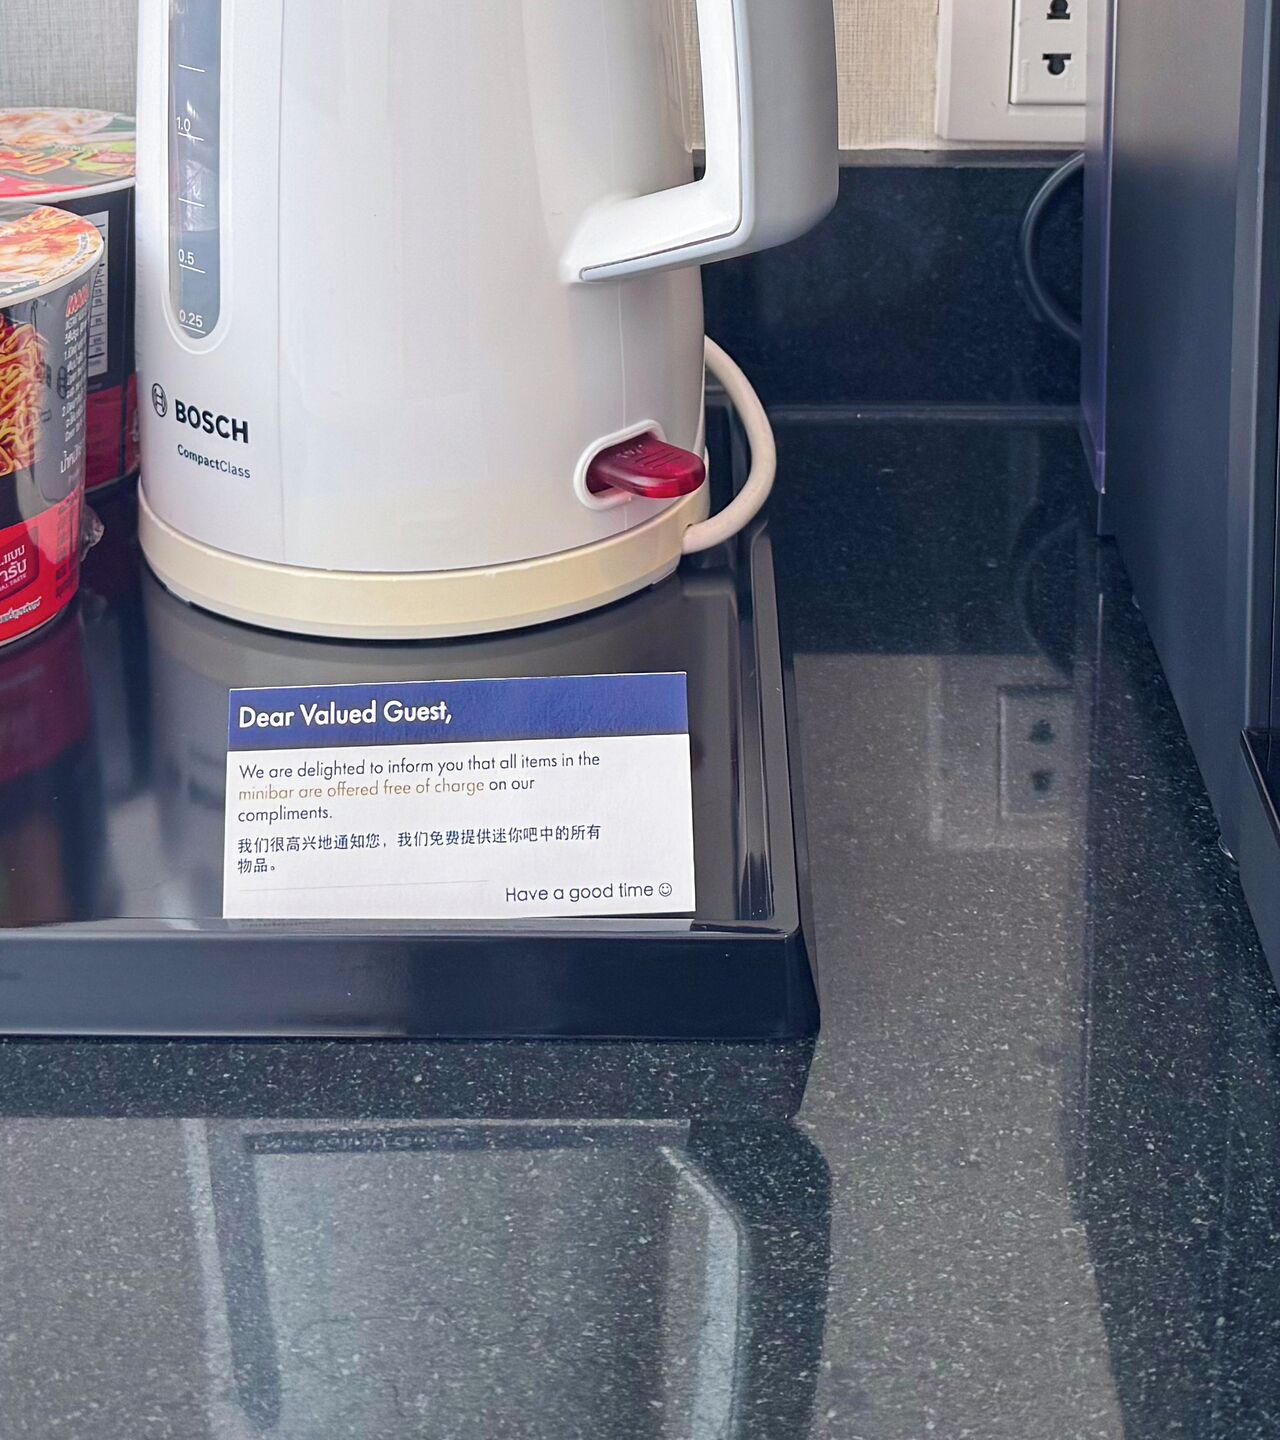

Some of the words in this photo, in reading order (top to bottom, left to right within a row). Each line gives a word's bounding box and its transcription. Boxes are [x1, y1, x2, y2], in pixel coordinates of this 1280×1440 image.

[177, 116, 191, 132] 1.0
[178, 248, 195, 265] 0.5
[179, 309, 203, 328] 0.25
[175, 399, 248, 444] BOSCH
[177, 444, 251, 479] CompactClass
[239, 706, 295, 729] Dear
[299, 700, 377, 726] Valued
[383, 700, 453, 725] Guest,
[239, 764, 264, 779] We
[269, 767, 293, 778] are
[297, 759, 365, 780] delighted
[370, 762, 383, 775] to
[388, 757, 433, 774] inform
[437, 761, 463, 776] you
[468, 755, 496, 771] that
[499, 753, 517, 769] all
[521, 753, 557, 769] items
[562, 753, 574, 767] in
[578, 751, 600, 767] the
[239, 785, 294, 801] minibar
[299, 787, 322, 798] are
[327, 780, 378, 798] offered
[383, 778, 411, 795] free
[416, 778, 430, 793] of
[434, 778, 484, 796] charge
[489, 780, 507, 791] on
[511, 778, 535, 790] our
[238, 804, 332, 825] compliments.
[237, 858, 275, 874] 物品。
[505, 887, 548, 902] Have
[553, 890, 564, 900] a
[569, 883, 613, 903] good
[619, 882, 653, 898] time
